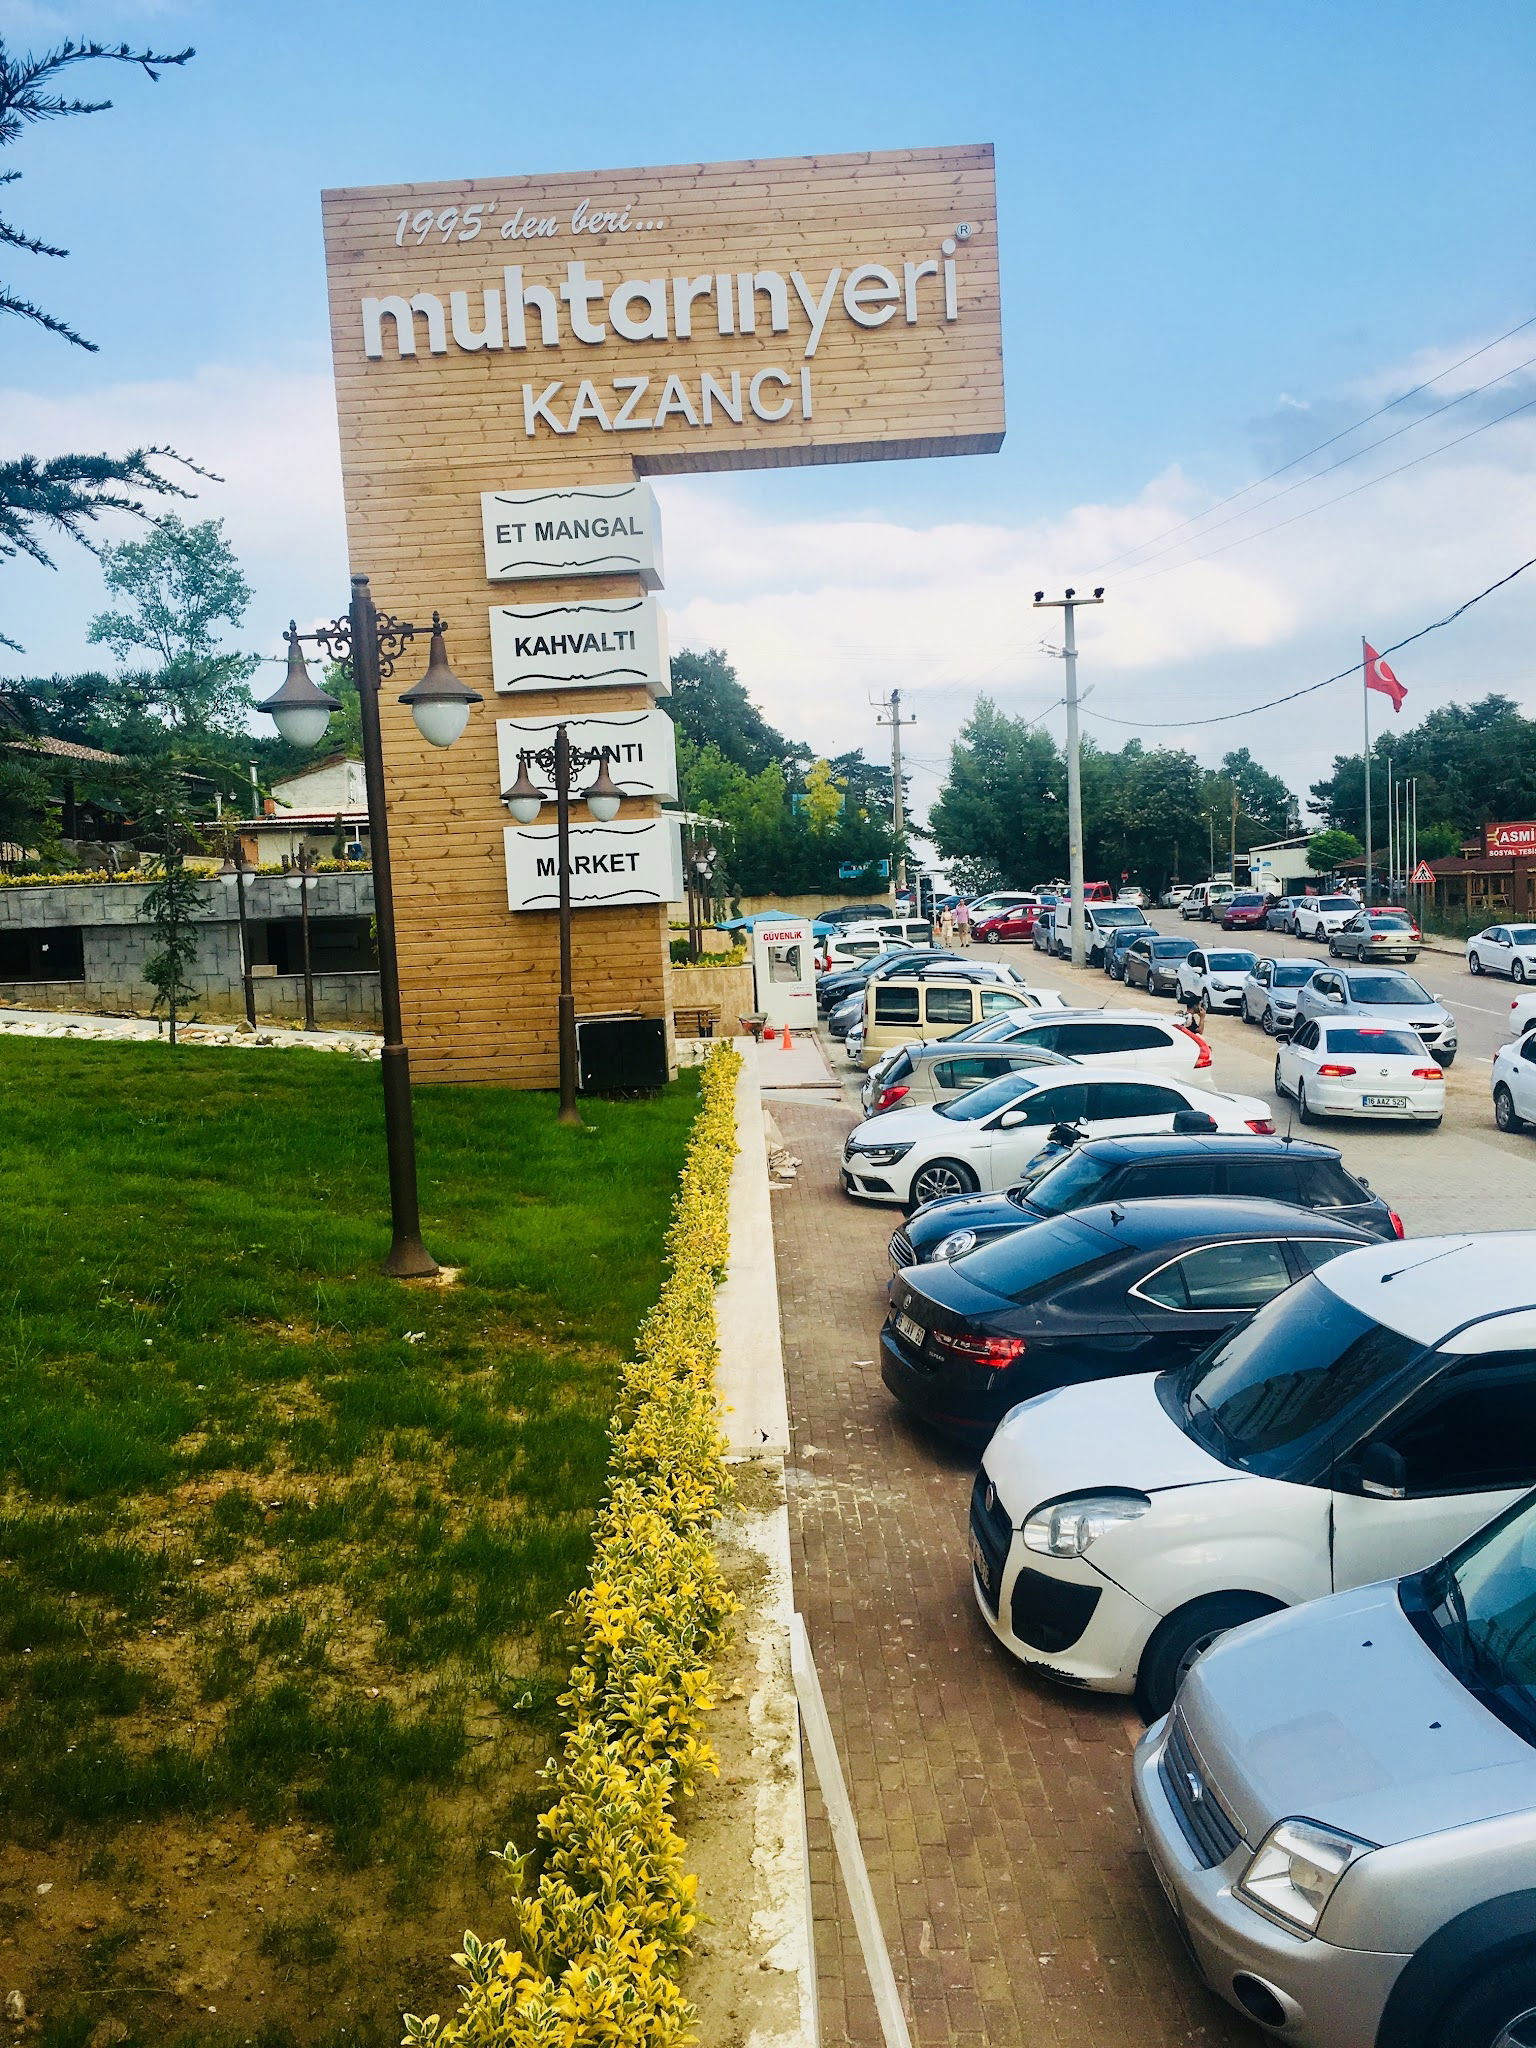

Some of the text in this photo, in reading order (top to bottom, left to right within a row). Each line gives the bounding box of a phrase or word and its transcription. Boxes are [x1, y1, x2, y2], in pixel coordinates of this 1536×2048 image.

[522, 366, 812, 437] KAZANCI
[496, 516, 644, 544] ET MANGAL
[514, 630, 636, 657] KAHVALTI
[763, 931, 802, 941] GÜVENLİK
